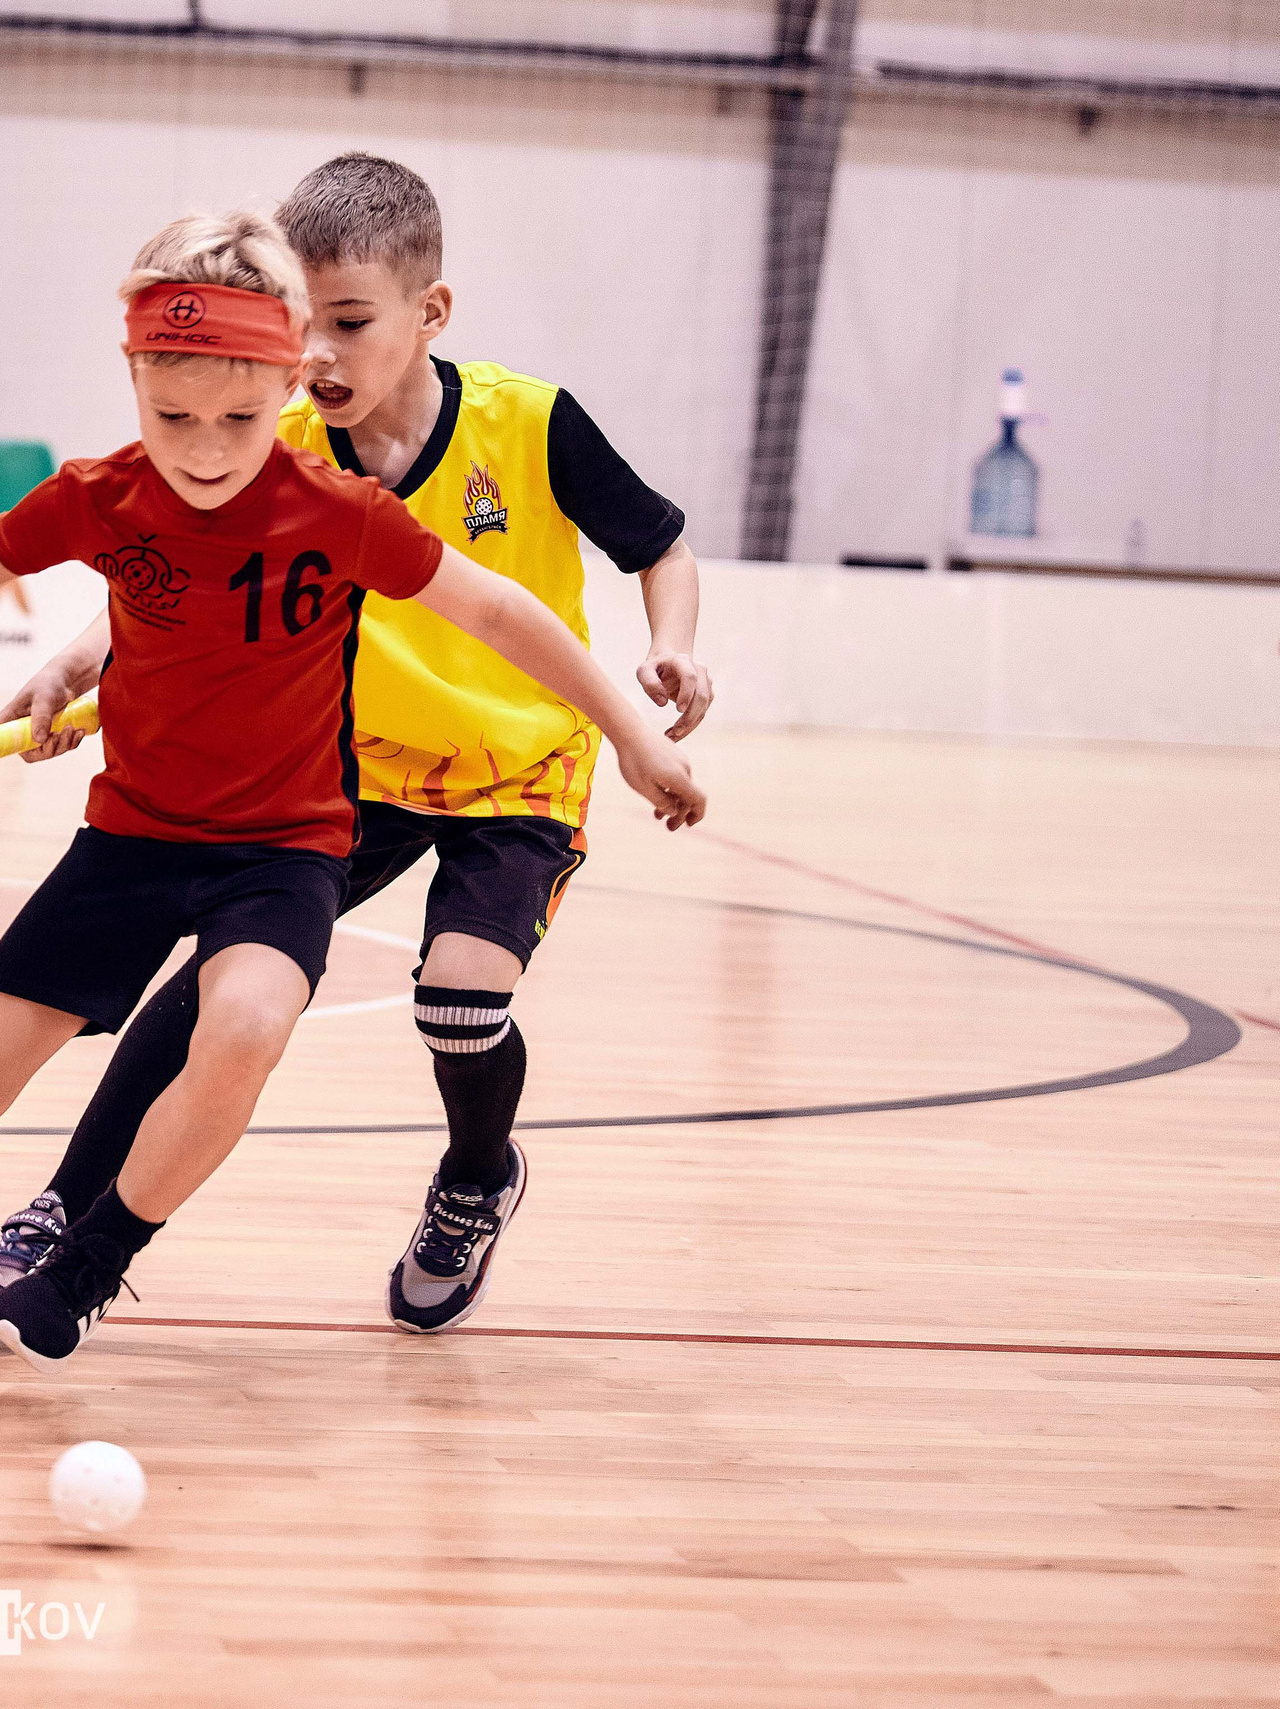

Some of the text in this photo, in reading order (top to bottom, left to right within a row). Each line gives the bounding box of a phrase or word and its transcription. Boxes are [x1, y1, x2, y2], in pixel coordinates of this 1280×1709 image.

[146, 331, 222, 345] UNIHOC
[465, 510, 506, 528] ПЛАМЯ
[228, 549, 333, 643] 16
